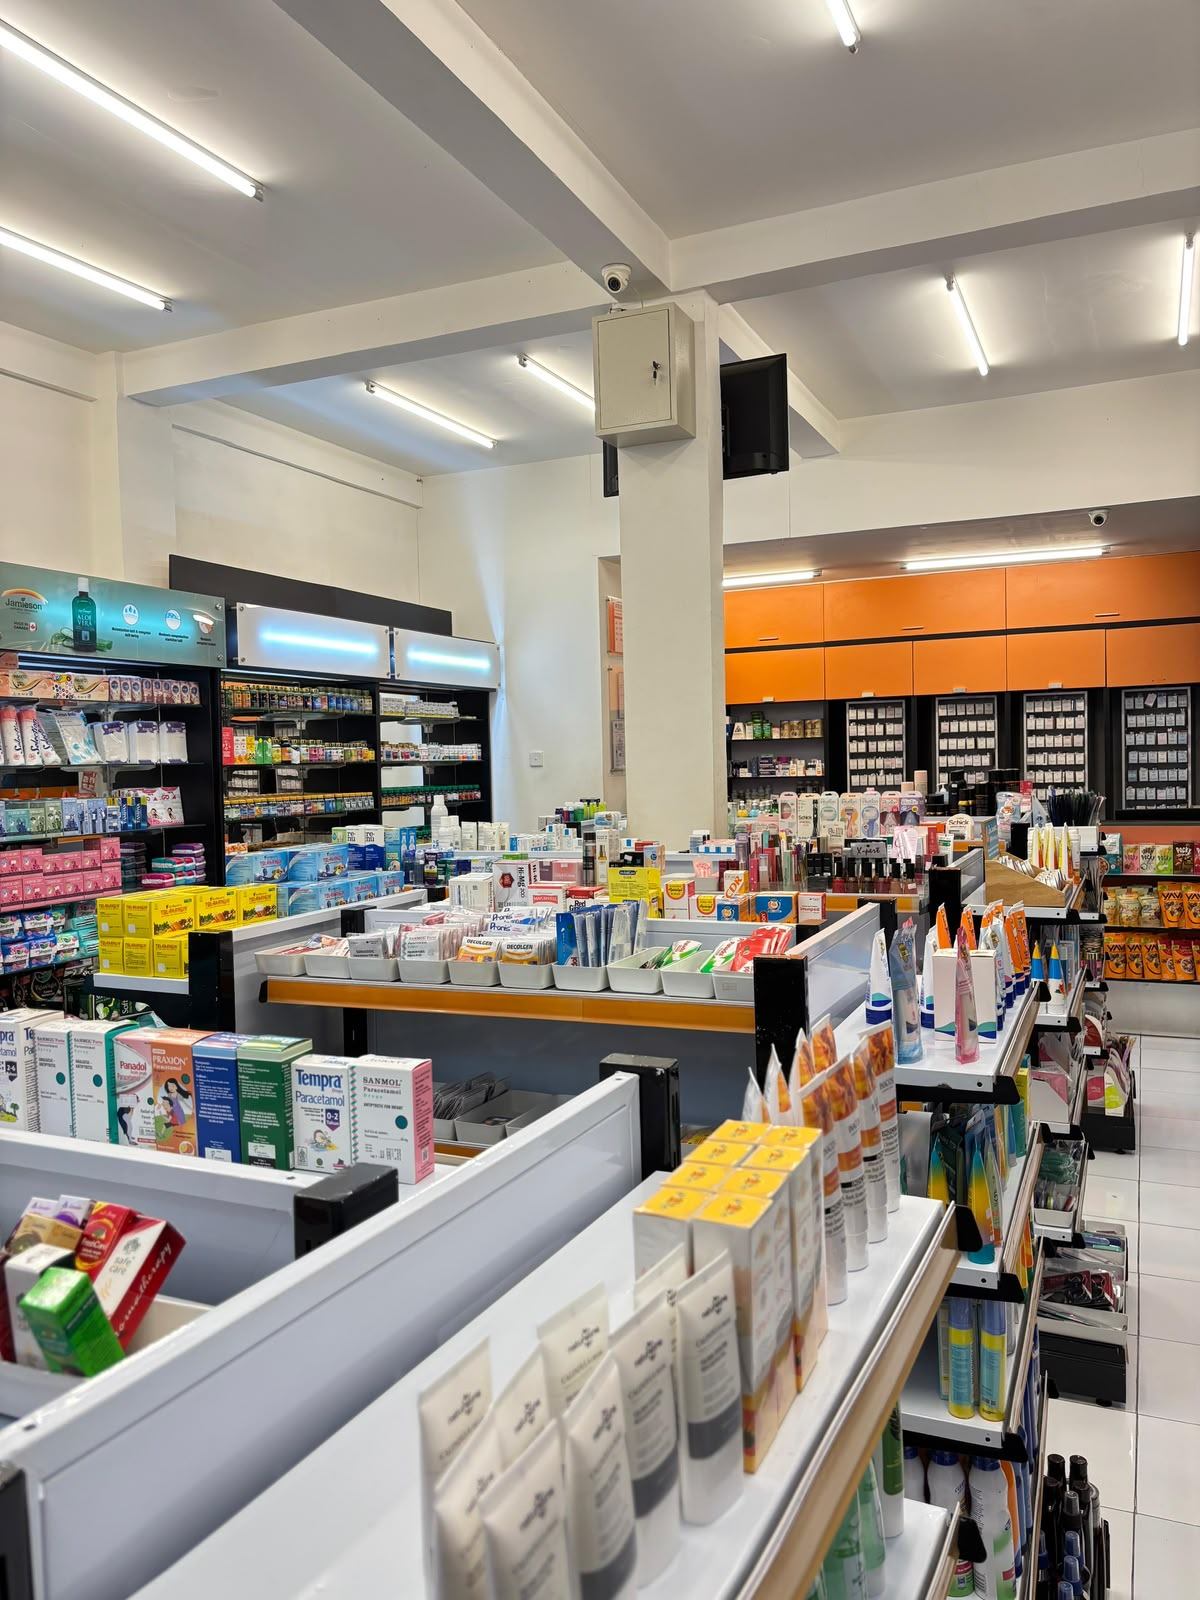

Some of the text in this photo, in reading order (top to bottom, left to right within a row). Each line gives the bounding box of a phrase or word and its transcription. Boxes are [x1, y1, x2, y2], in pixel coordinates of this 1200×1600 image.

[6, 598, 42, 610] Jamieson
[856, 847, 881, 856] X-pert
[725, 874, 743, 898] CDR
[466, 938, 493, 946] DECOLGEN
[121, 999, 129, 1014] Soft
[120, 1060, 147, 1071] Panadol
[152, 1055, 186, 1065] PRAXION
[295, 1069, 342, 1091] Tempra
[363, 1076, 401, 1086] SANMOL
[363, 1086, 401, 1095] Paracetamol
[295, 1090, 345, 1107] Paracetamol
[326, 1112, 340, 1121] 0-2
[114, 1241, 173, 1337] romatherapy
